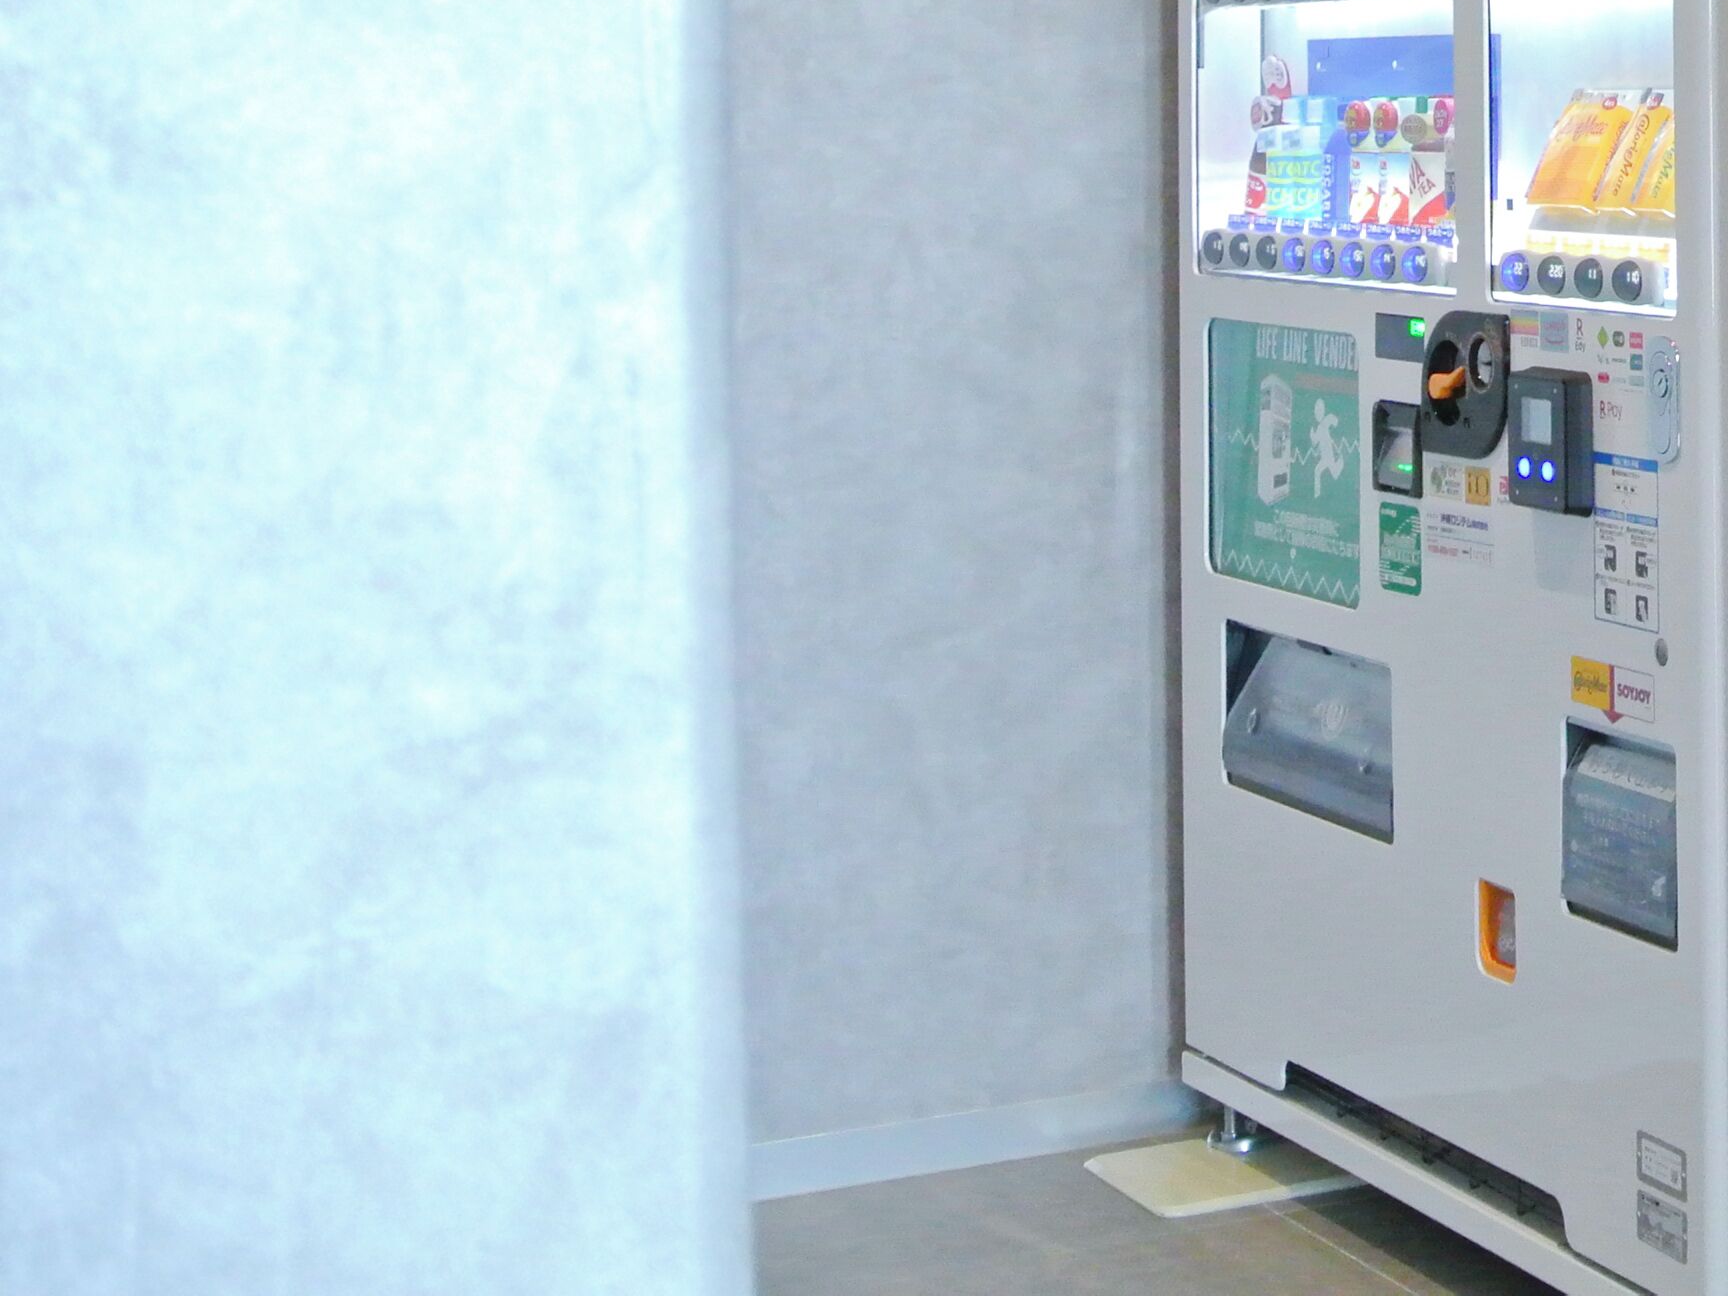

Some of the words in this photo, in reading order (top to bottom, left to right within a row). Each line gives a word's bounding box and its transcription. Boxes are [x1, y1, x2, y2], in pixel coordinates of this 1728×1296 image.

[1256, 325, 1278, 361] LIFE
[1283, 328, 1308, 366] LINE
[1607, 402, 1623, 420] Pay
[1617, 682, 1651, 706] SOYJOY
